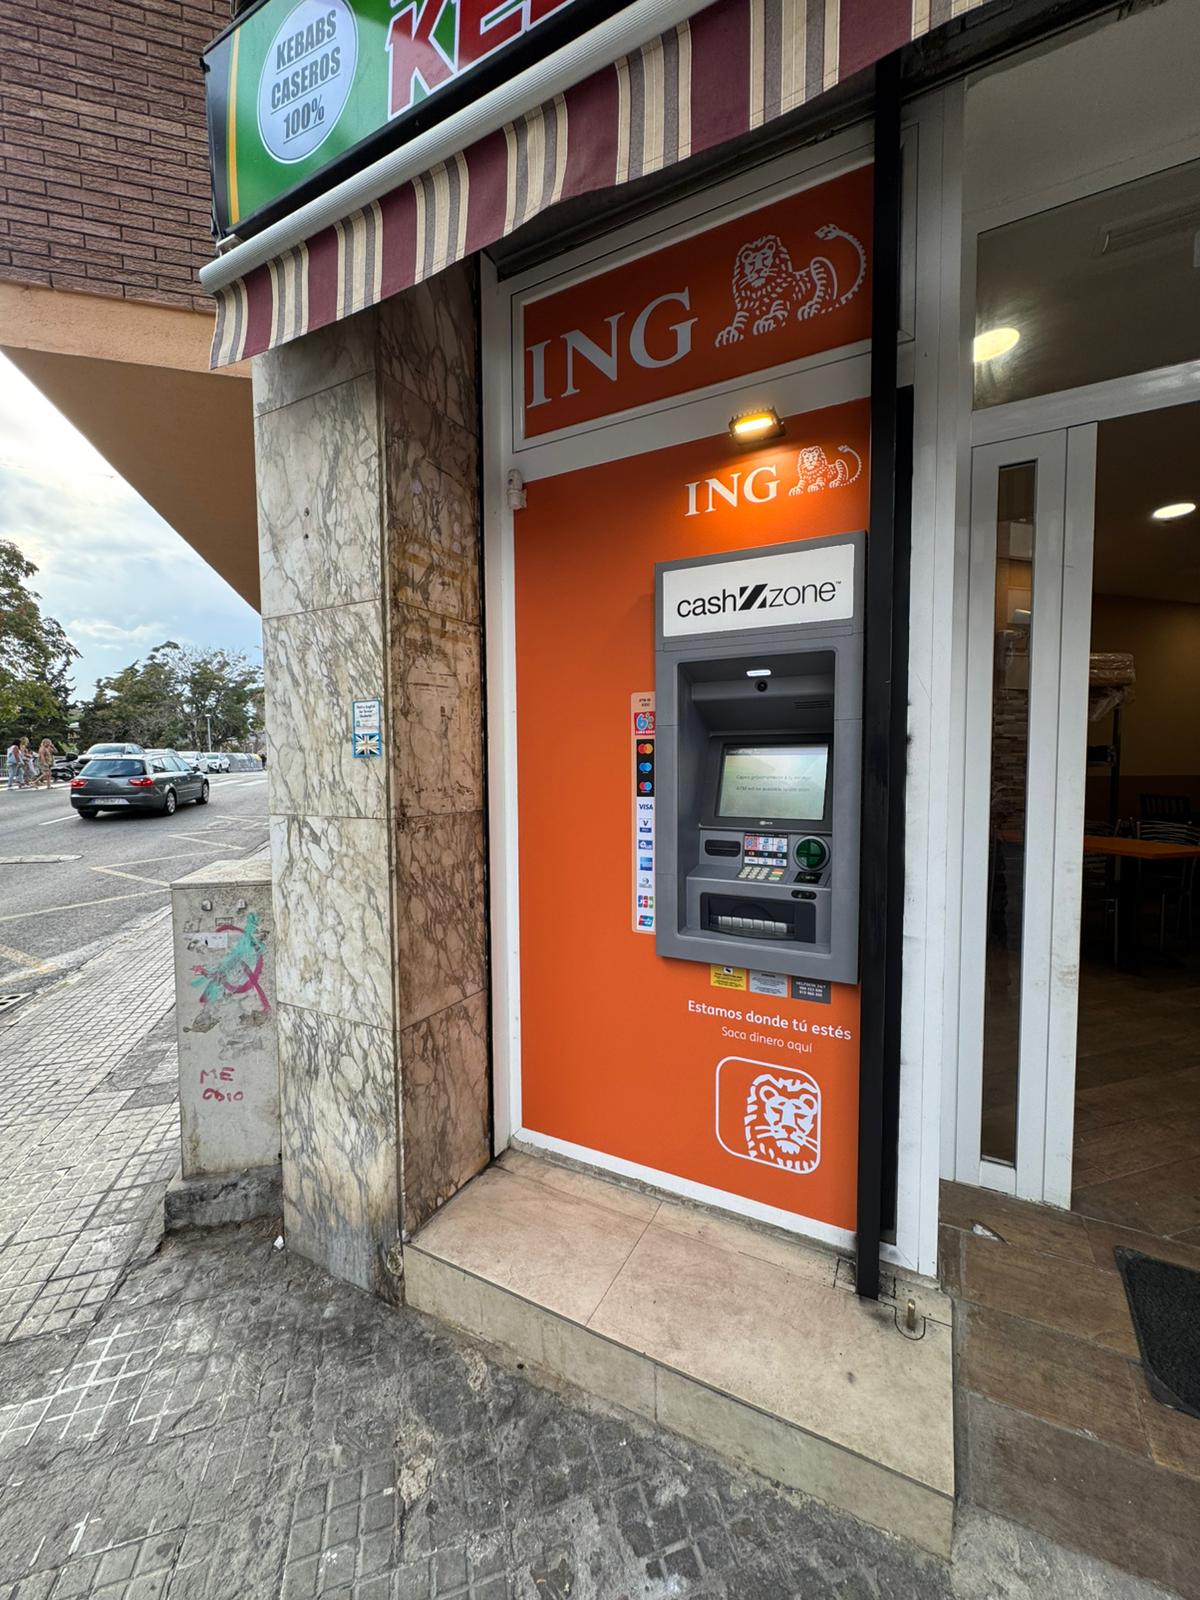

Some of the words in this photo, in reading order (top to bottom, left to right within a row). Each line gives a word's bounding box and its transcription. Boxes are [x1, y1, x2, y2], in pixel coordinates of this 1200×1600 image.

[276, 9, 337, 70] KEBABS
[271, 46, 341, 110] CASEROS
[283, 95, 325, 140] 100%
[526, 286, 698, 409] ING
[684, 464, 781, 517] ING
[677, 588, 737, 618] cash
[688, 999, 743, 1021] Estamos
[745, 1010, 789, 1029] donde
[792, 1018, 808, 1033] tú
[811, 1022, 852, 1041] estés
[721, 1026, 747, 1040] Saca
[749, 1032, 785, 1048] dinero
[787, 1040, 813, 1054] aquí
